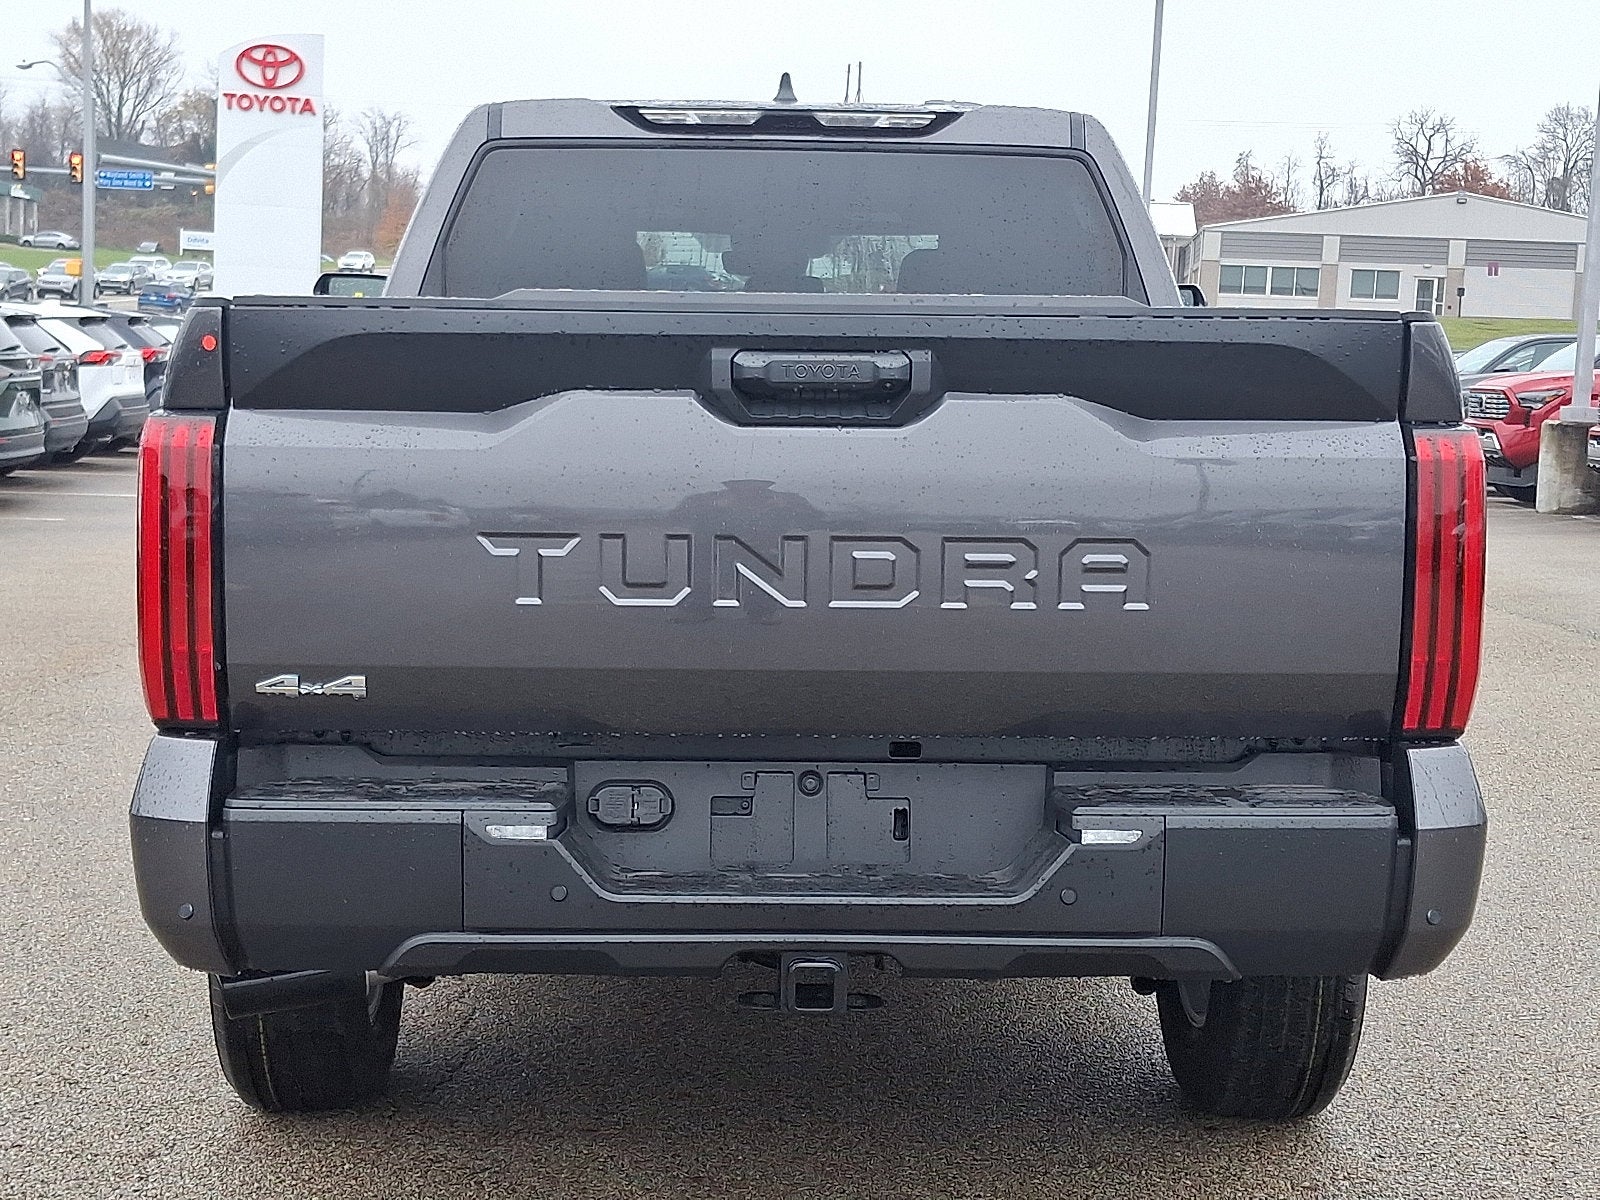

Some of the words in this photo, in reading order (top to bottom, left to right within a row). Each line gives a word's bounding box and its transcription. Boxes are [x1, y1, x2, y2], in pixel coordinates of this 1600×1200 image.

[223, 93, 316, 116] TOYOTA
[781, 363, 860, 379] TOYOTA
[477, 531, 1151, 611] TUNDRA
[255, 674, 367, 699] 4x4
